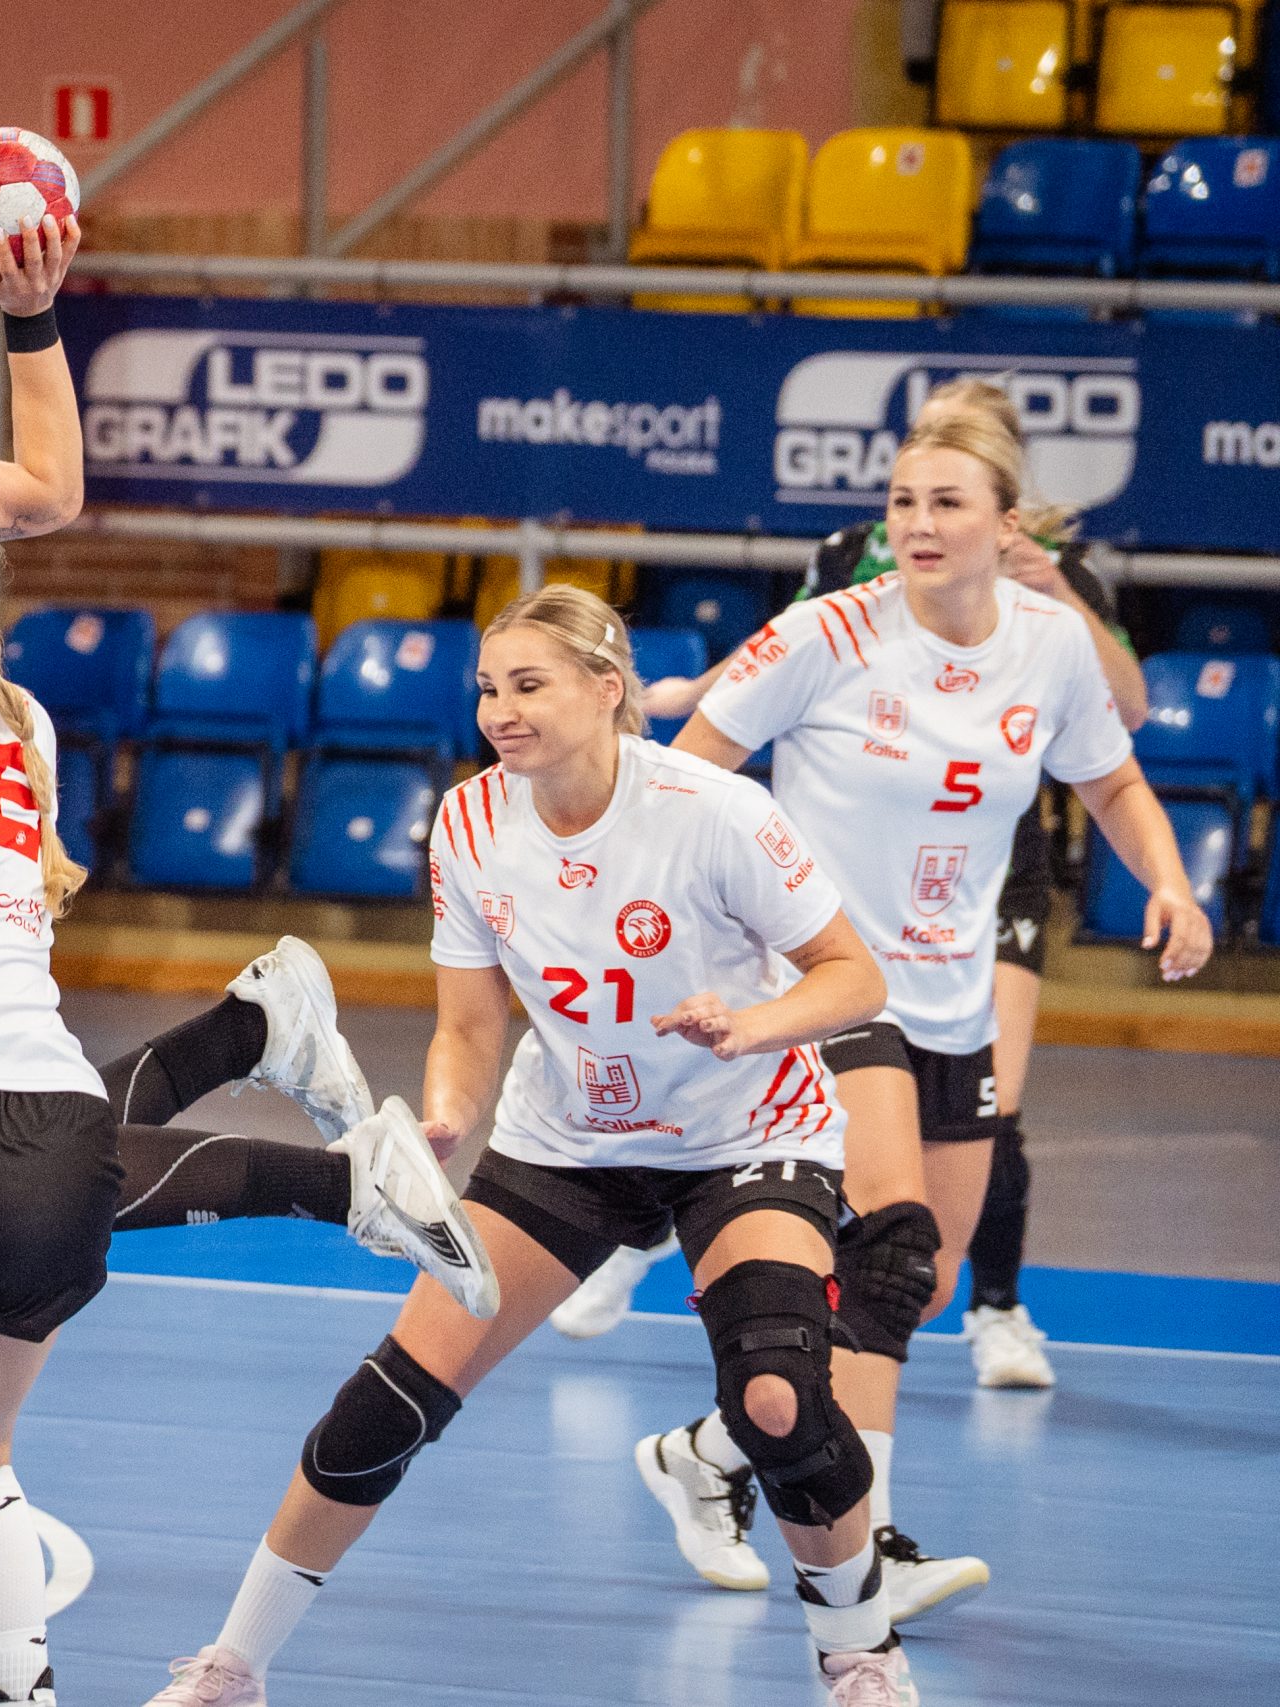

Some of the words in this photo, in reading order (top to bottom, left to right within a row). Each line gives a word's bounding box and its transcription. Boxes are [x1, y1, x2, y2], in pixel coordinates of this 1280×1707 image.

[209, 348, 427, 410] LEDO
[477, 388, 721, 458] makesport
[774, 428, 896, 491] GRA
[863, 739, 910, 761] Kalisz
[930, 761, 984, 813] 5
[901, 922, 956, 945] Kalisz
[541, 966, 635, 1025] 21
[976, 1076, 998, 1117] 5
